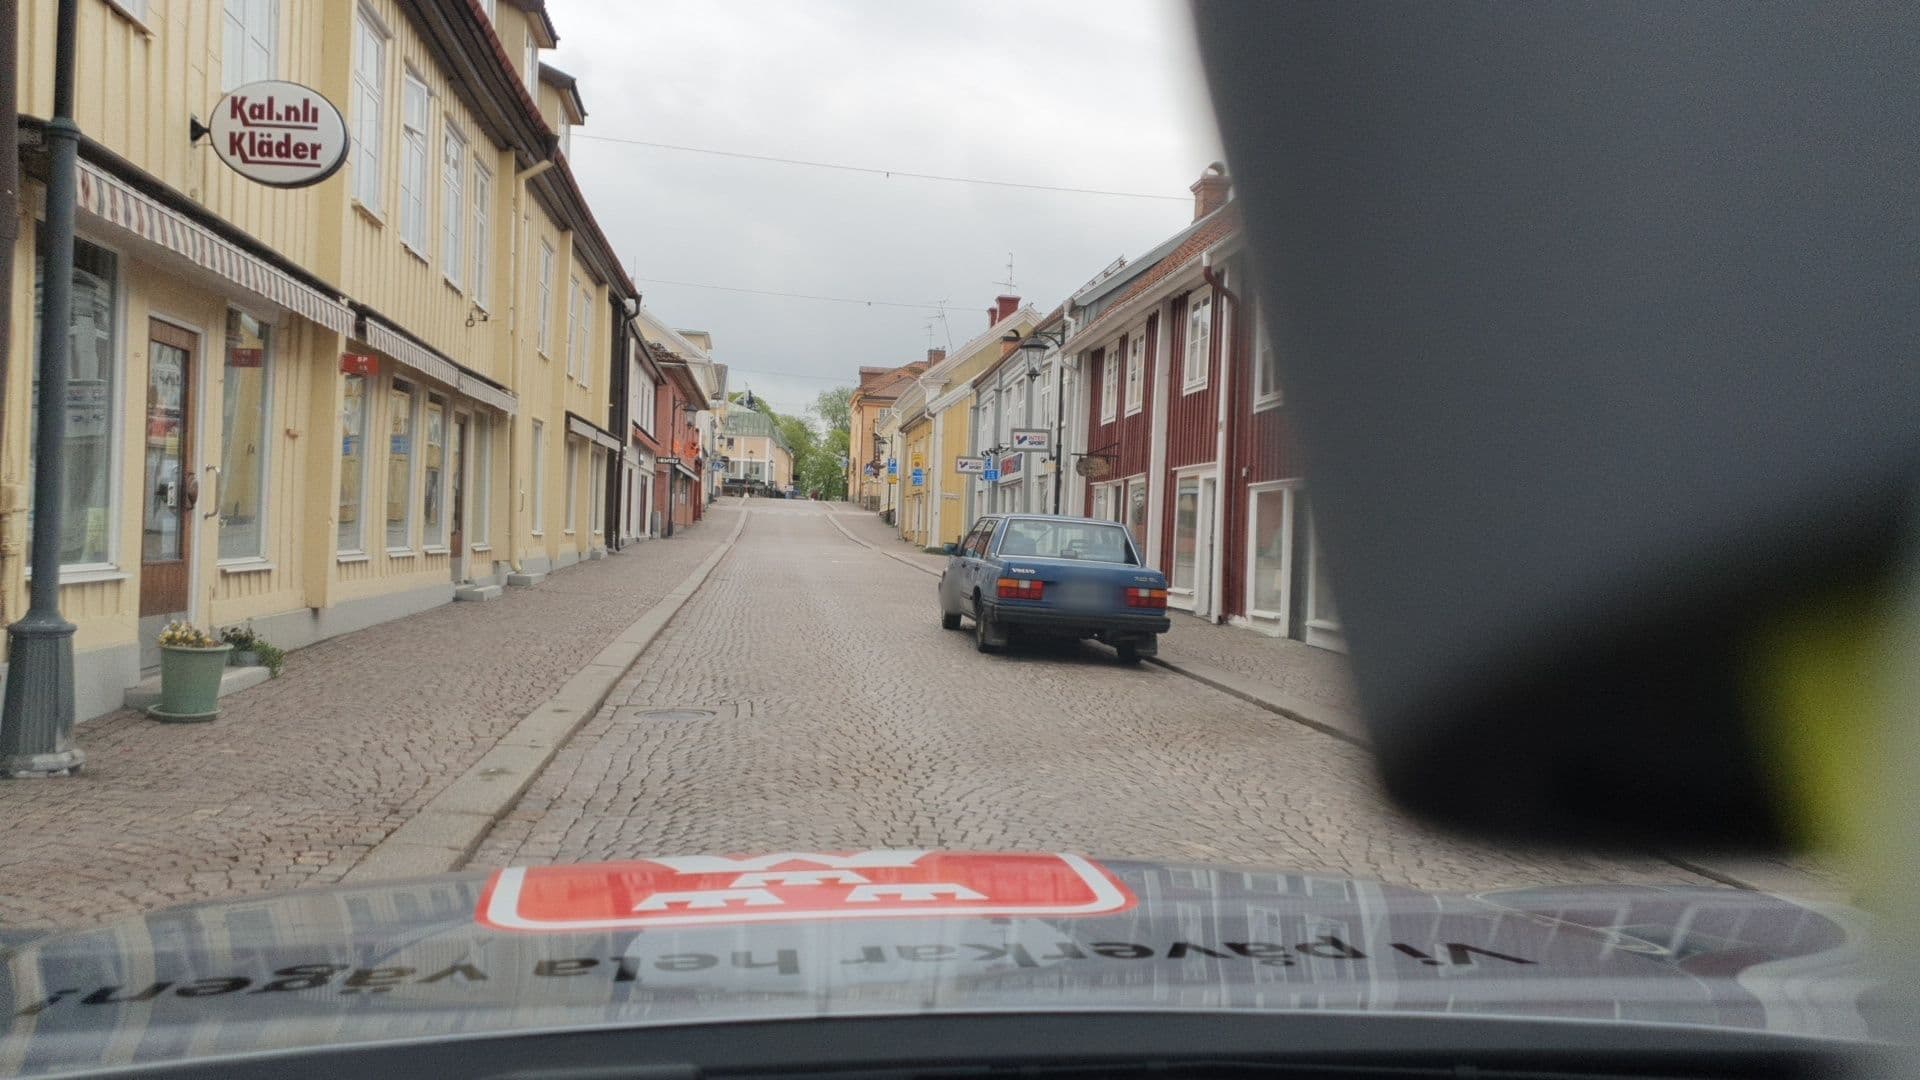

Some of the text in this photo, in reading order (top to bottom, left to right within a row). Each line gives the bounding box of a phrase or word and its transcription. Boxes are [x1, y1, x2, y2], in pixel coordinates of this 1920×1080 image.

[228, 131, 322, 166] Kläder
[532, 948, 799, 982] hela
[839, 935, 1368, 968] påverkar
[1390, 941, 1539, 966] Vi
